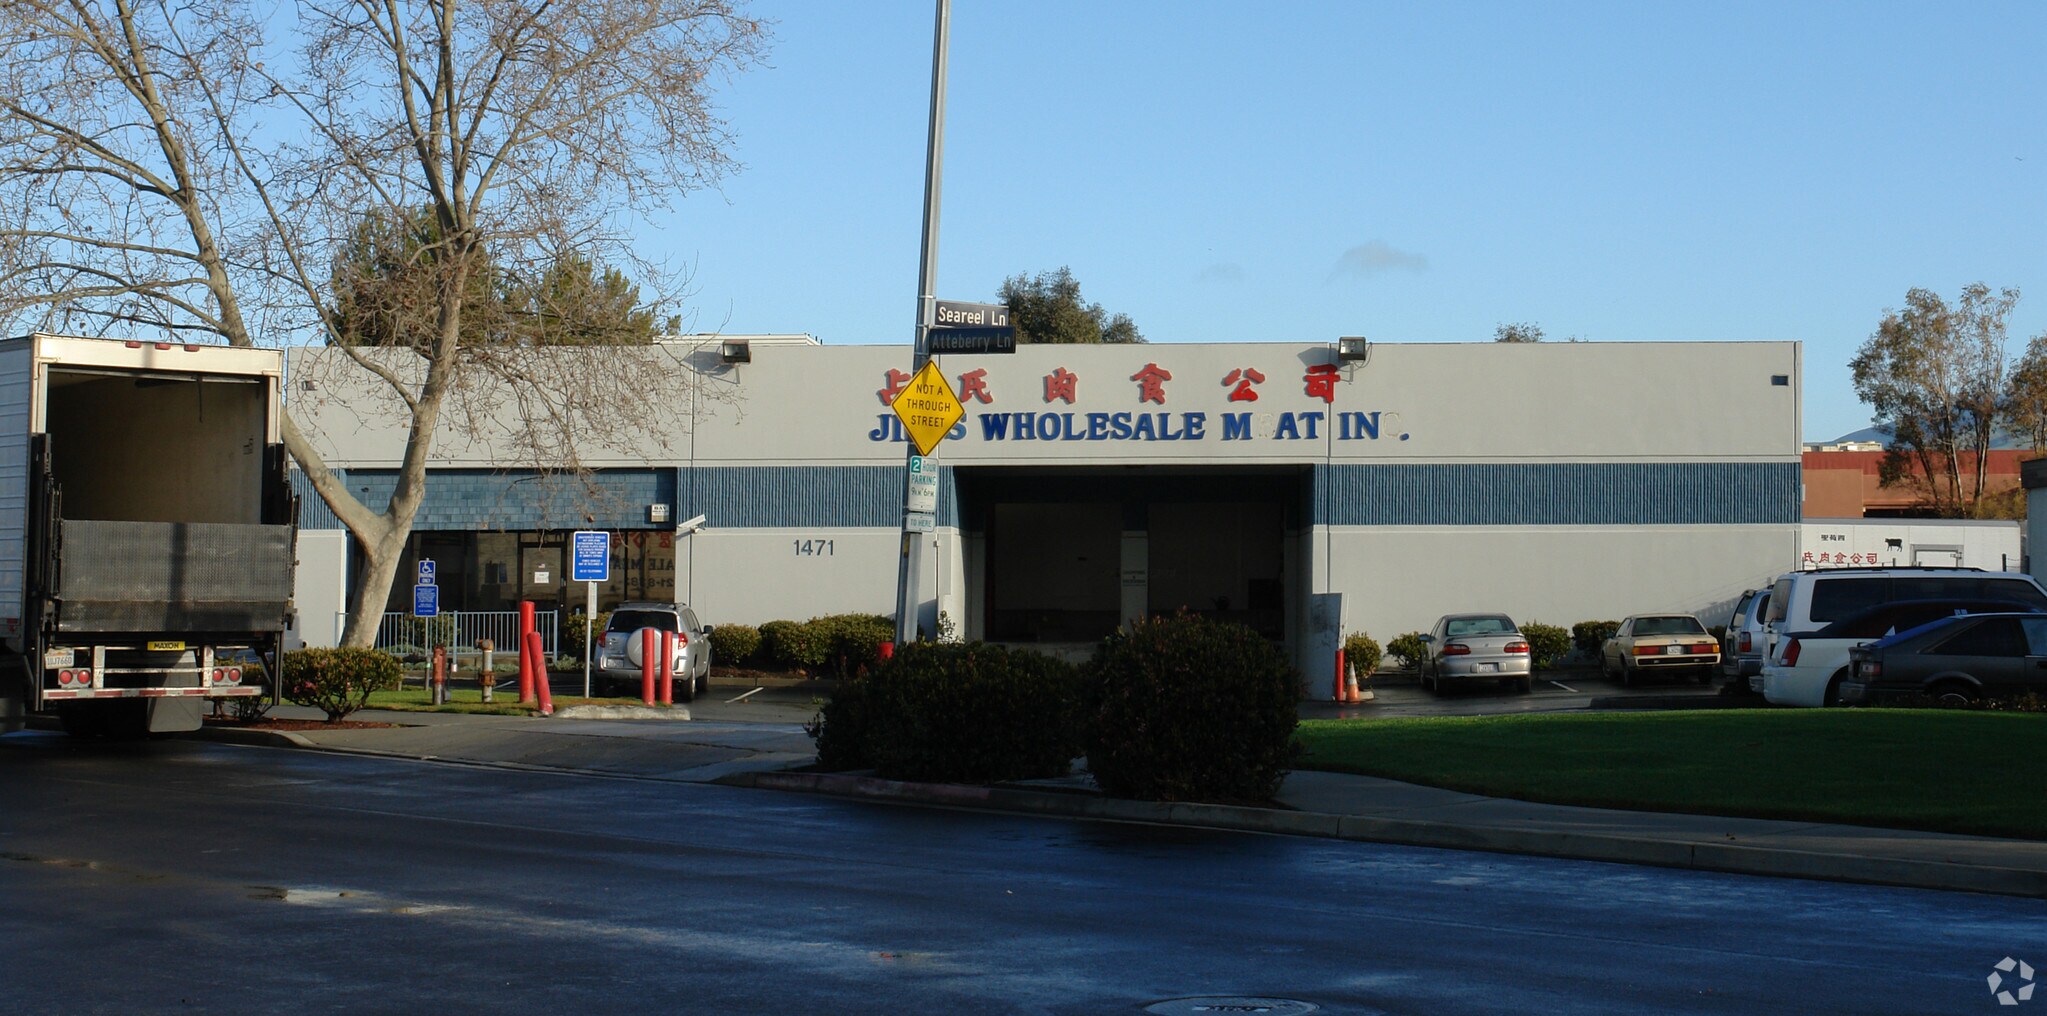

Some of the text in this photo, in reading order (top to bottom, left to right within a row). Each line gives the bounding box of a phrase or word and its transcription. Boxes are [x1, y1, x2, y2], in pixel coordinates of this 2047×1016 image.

[938, 306, 1007, 326] Seareel Ln
[932, 333, 1011, 353] Atteberry Ln
[915, 383, 944, 396] NOT A
[906, 398, 951, 412] THROUGH
[868, 413, 967, 442] JIS
[977, 411, 1208, 441] WHOLESALE
[1220, 411, 1325, 441] MAT
[910, 414, 945, 428] STREET
[912, 459, 920, 472] 2
[911, 474, 937, 485] PARKING
[793, 539, 834, 556] 1471
